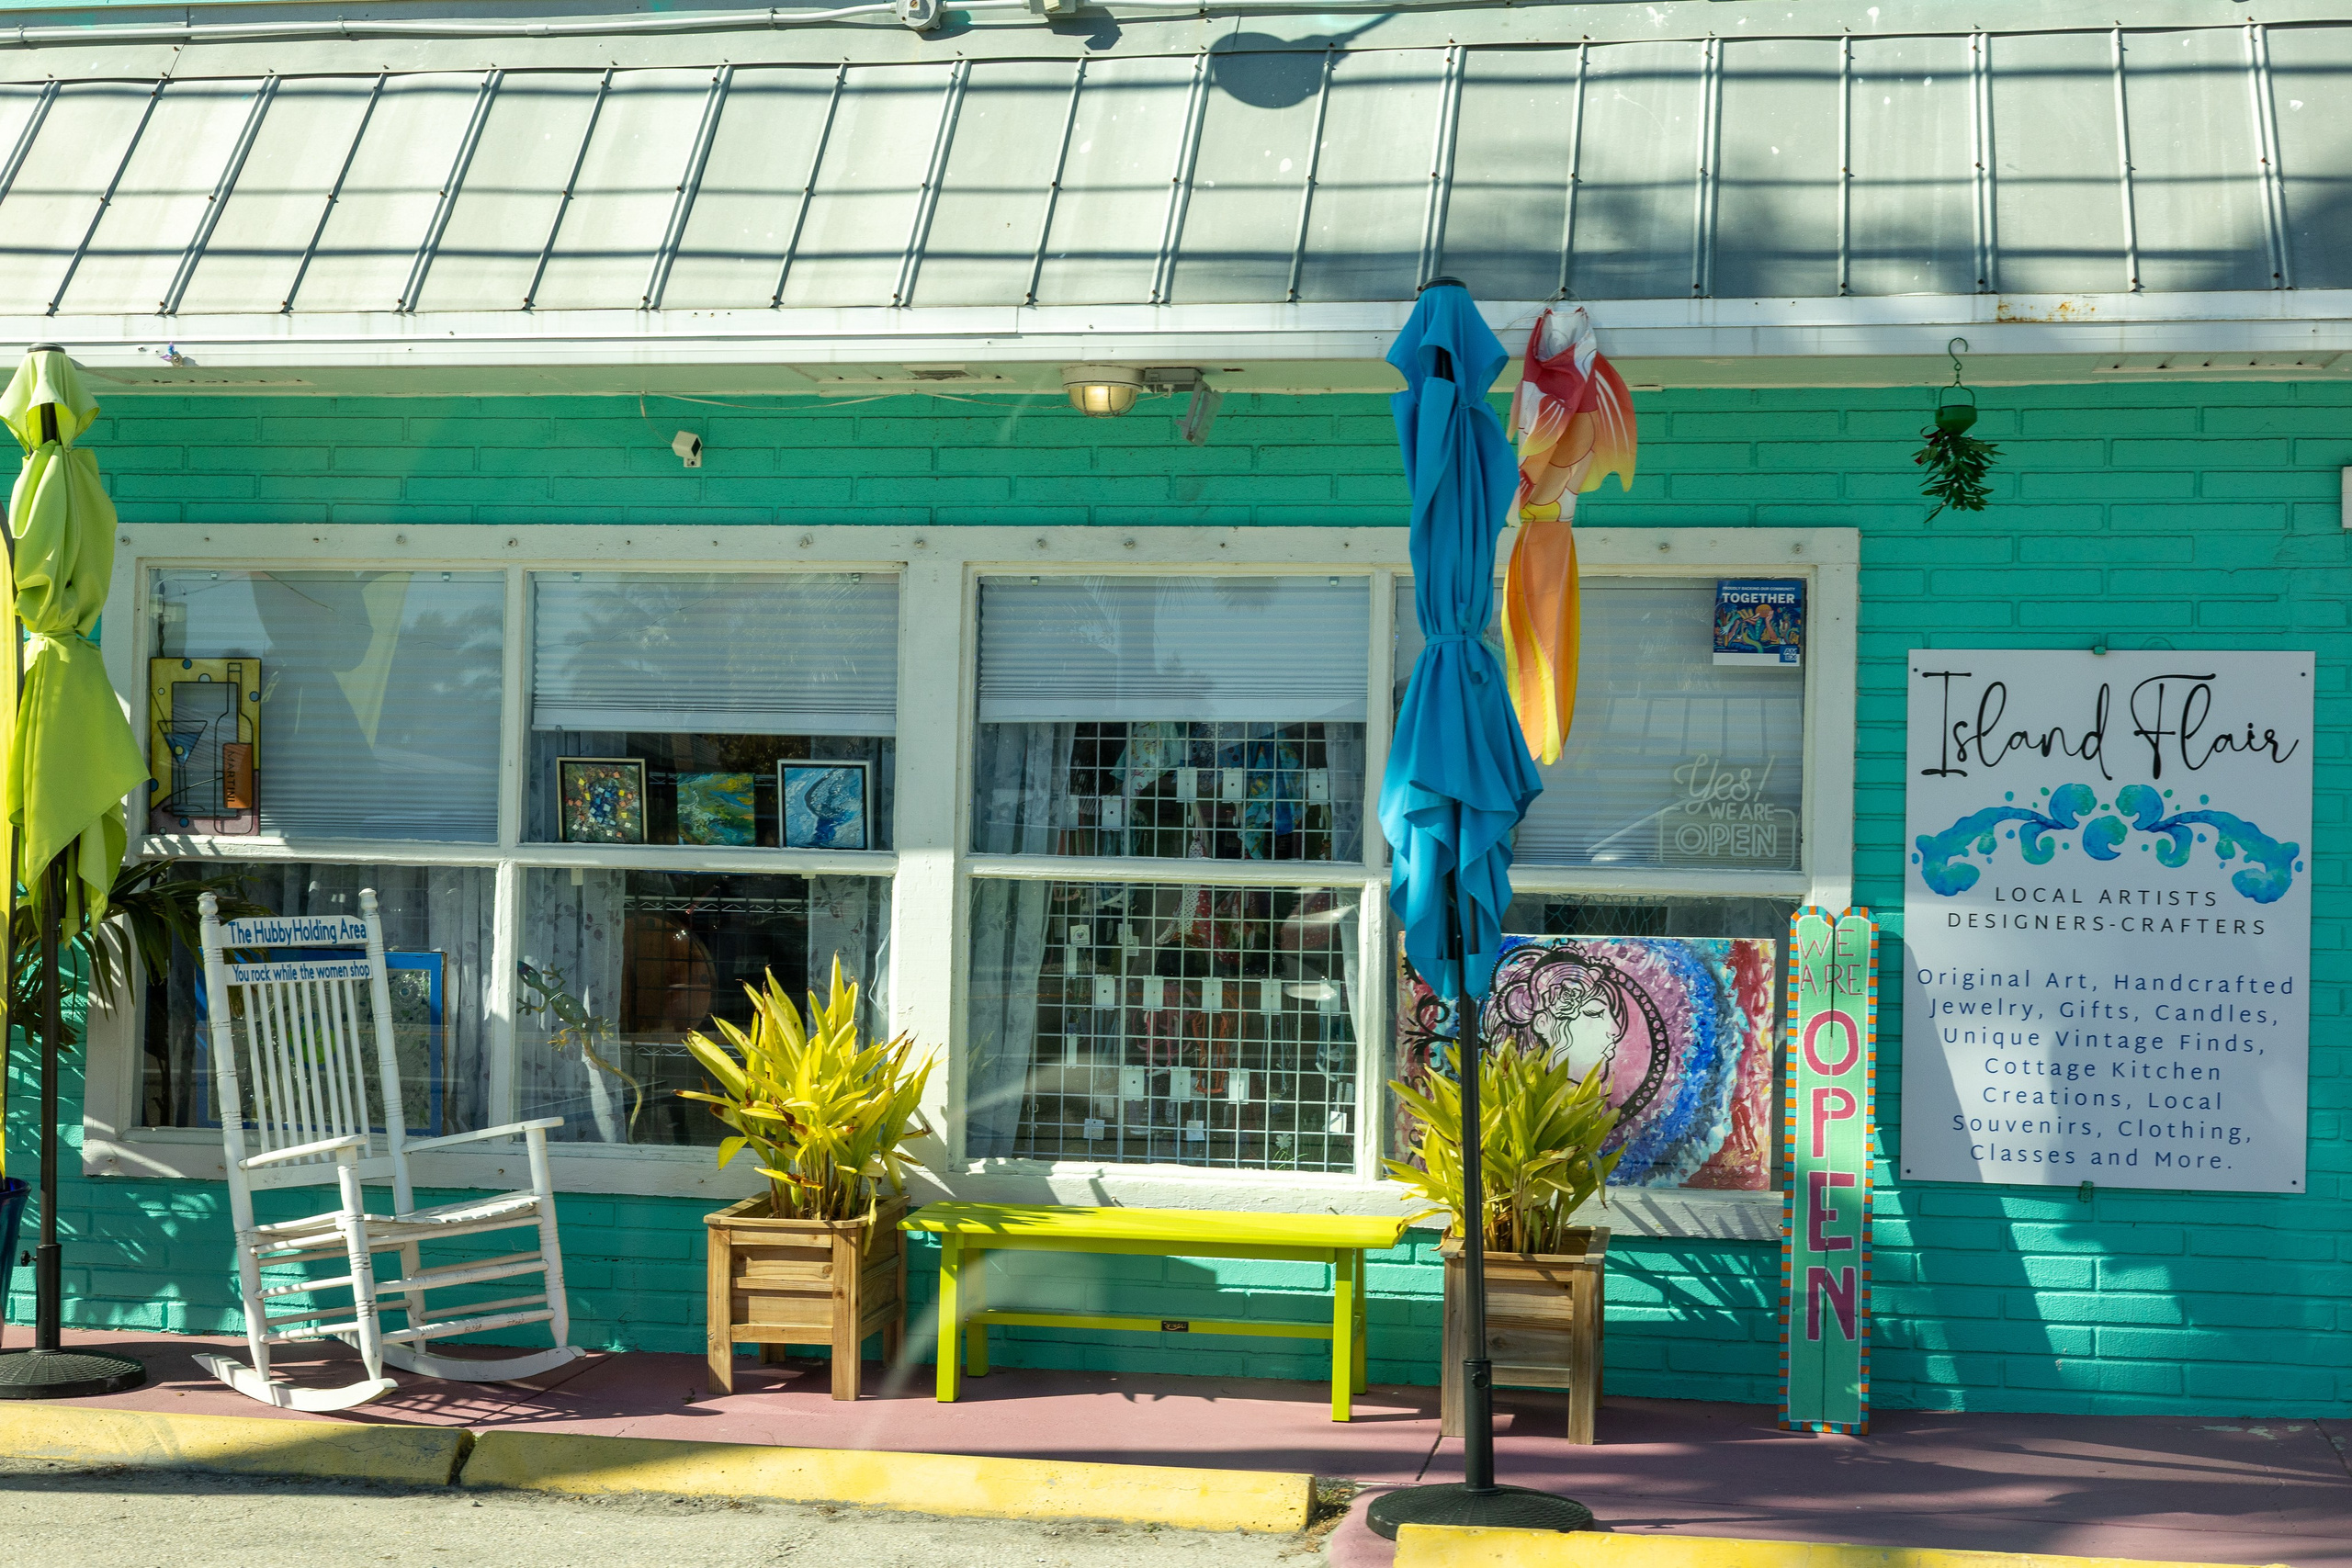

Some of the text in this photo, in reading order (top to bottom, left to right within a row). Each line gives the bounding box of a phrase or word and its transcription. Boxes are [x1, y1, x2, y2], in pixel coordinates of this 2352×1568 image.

[1722, 592, 1795, 604] TOGETHER
[1921, 671, 2299, 781] Island Flair
[226, 750, 236, 803] MARTINI
[1674, 753, 1775, 815] Yes!
[1708, 803, 1775, 821] WE ARE
[1675, 823, 1778, 857] OPEN
[1996, 886, 2217, 908] LOCAL ARTISTS
[228, 921, 252, 944] The
[340, 918, 367, 940] Area
[1948, 912, 2266, 936] DESIGNERS-CRAFTERS
[1799, 929, 1855, 960] WE
[232, 961, 370, 982] You rock while the women shop
[1800, 964, 1864, 997] ARE
[1917, 968, 2293, 995] Original Art, Handcrafted
[1928, 998, 2278, 1026] Jewelry, Gifts, Candles,
[1943, 1027, 2264, 1055] Unique Vintage Finds,
[1984, 1057, 2220, 1081] Cottage Kitchen
[1983, 1087, 2222, 1111] Creations, Local
[1952, 1114, 2251, 1145] Souvenirs, Clothing,
[1970, 1143, 2233, 1169] Classes and More.
[1804, 1009, 1860, 1342] OPEN
